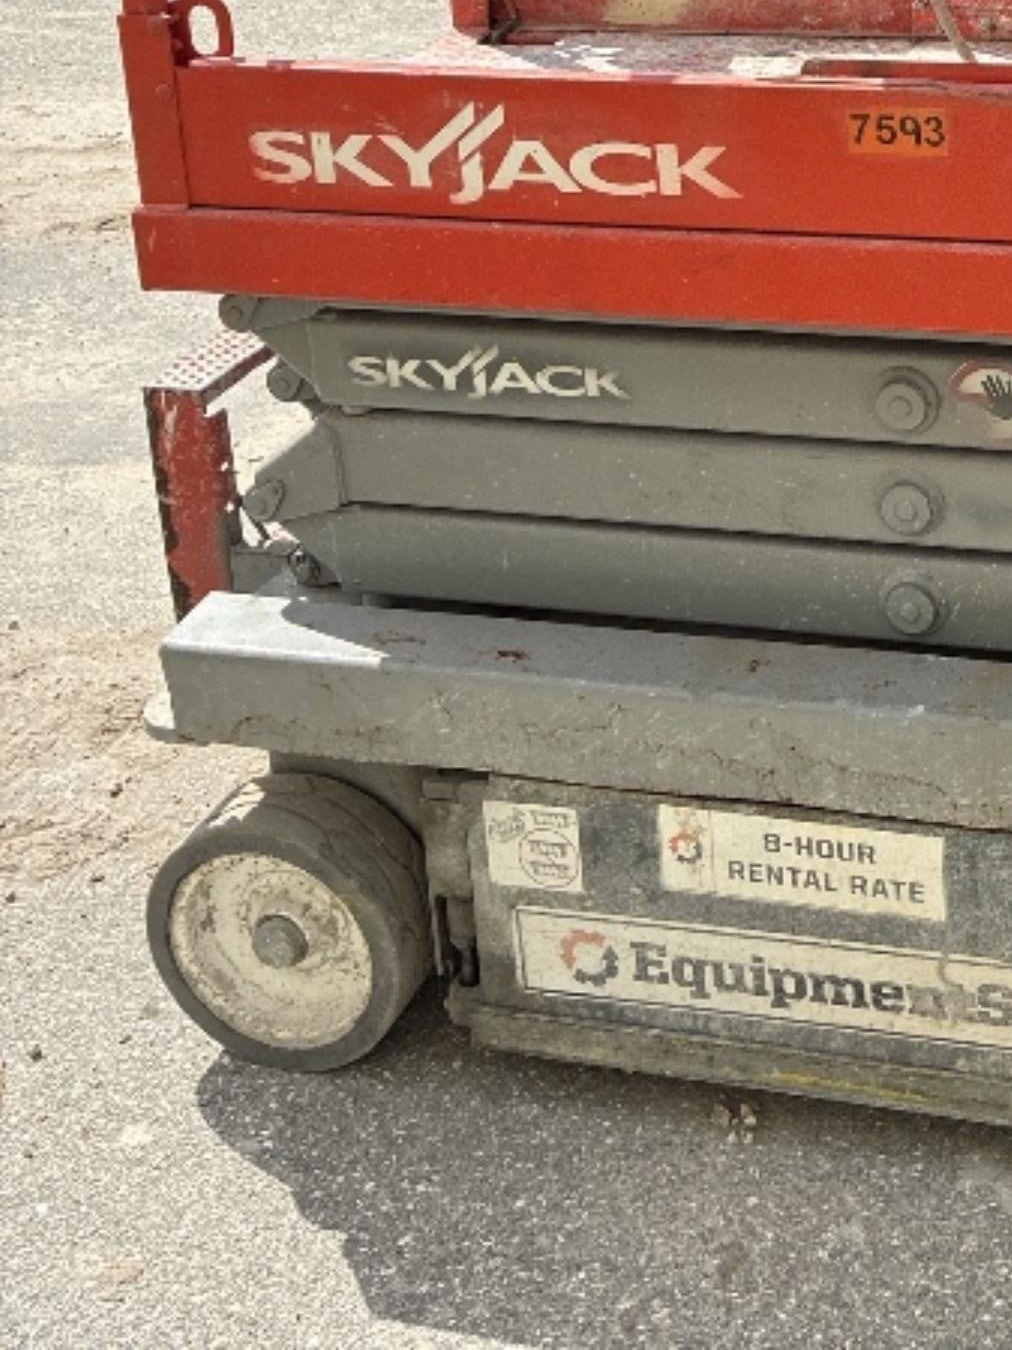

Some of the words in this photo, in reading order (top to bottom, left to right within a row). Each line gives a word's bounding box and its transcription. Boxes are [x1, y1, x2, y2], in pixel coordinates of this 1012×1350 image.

[248, 102, 743, 204] SKYJACK
[848, 113, 946, 147] 7593
[347, 345, 631, 400] SKYJACK
[728, 860, 839, 893] RENTAL
[850, 875, 926, 904] RATE
